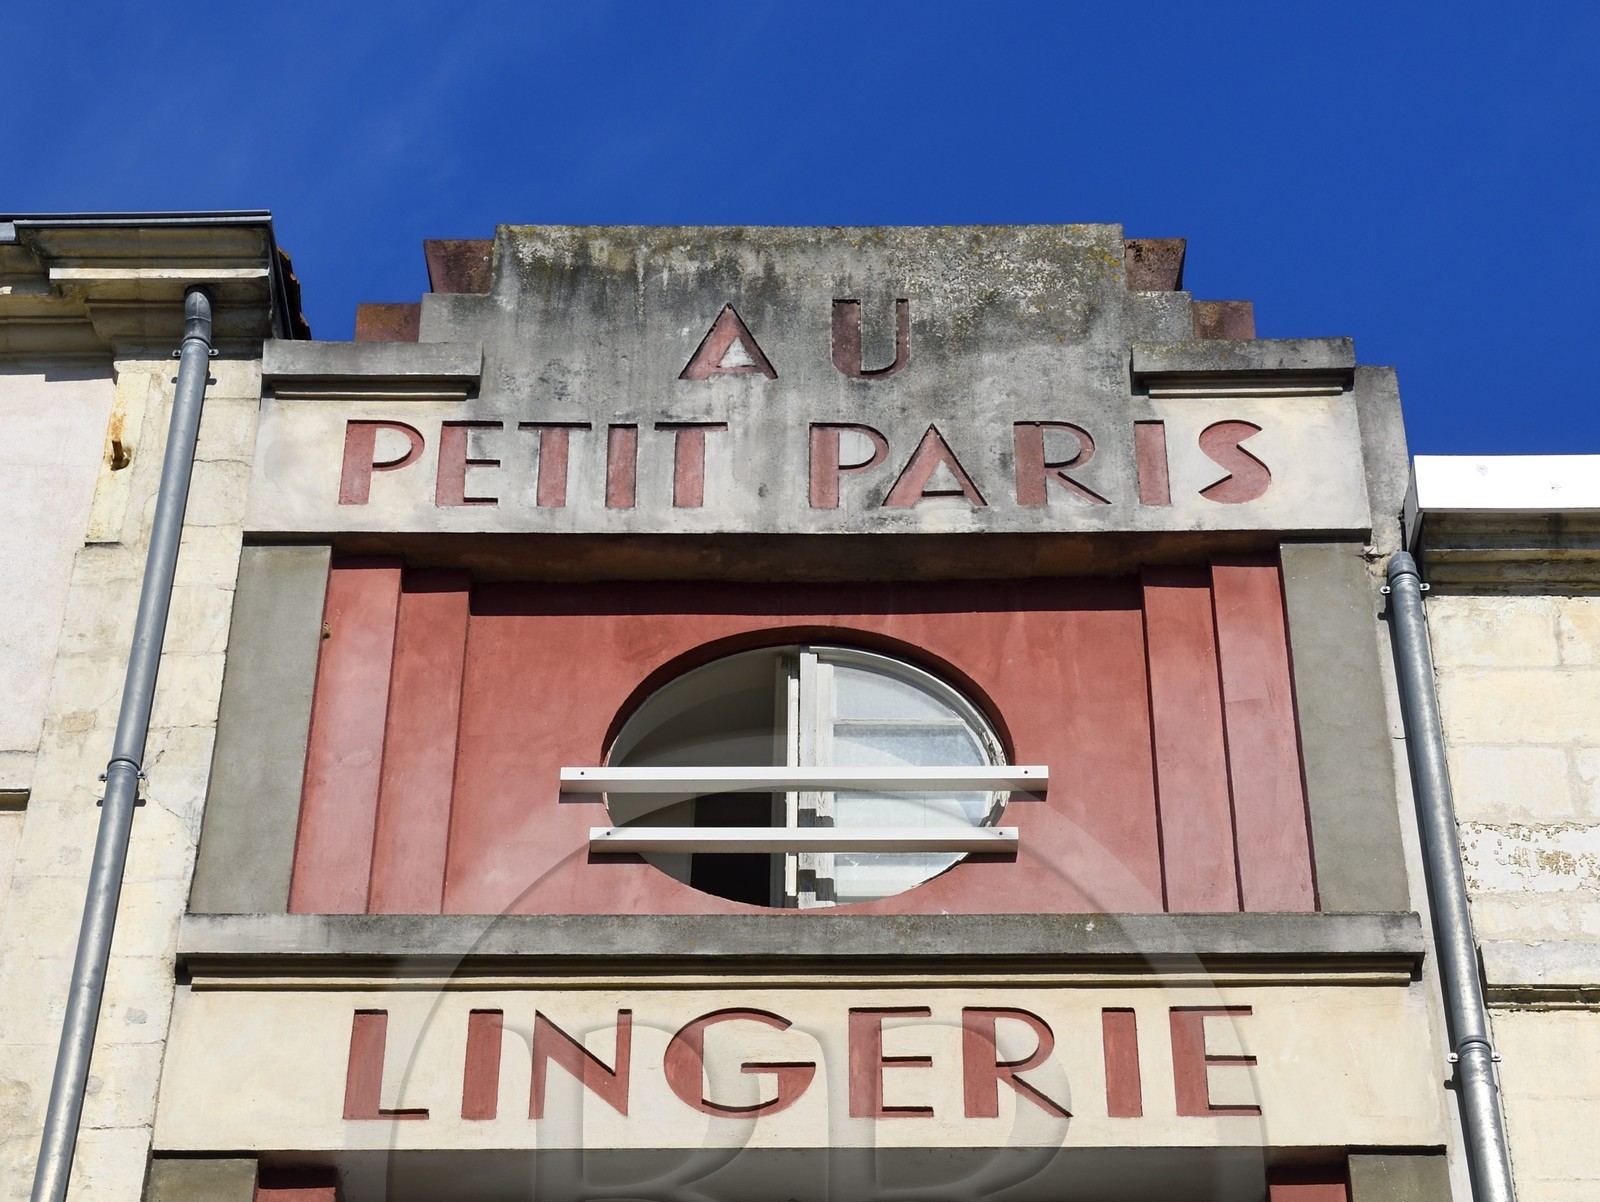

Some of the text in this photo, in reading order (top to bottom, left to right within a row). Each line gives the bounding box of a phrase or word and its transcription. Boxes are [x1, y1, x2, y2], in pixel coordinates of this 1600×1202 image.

[679, 298, 909, 380] AU
[339, 419, 1272, 507] PETIT PARIS
[343, 1006, 1261, 1120] LINGERIE
